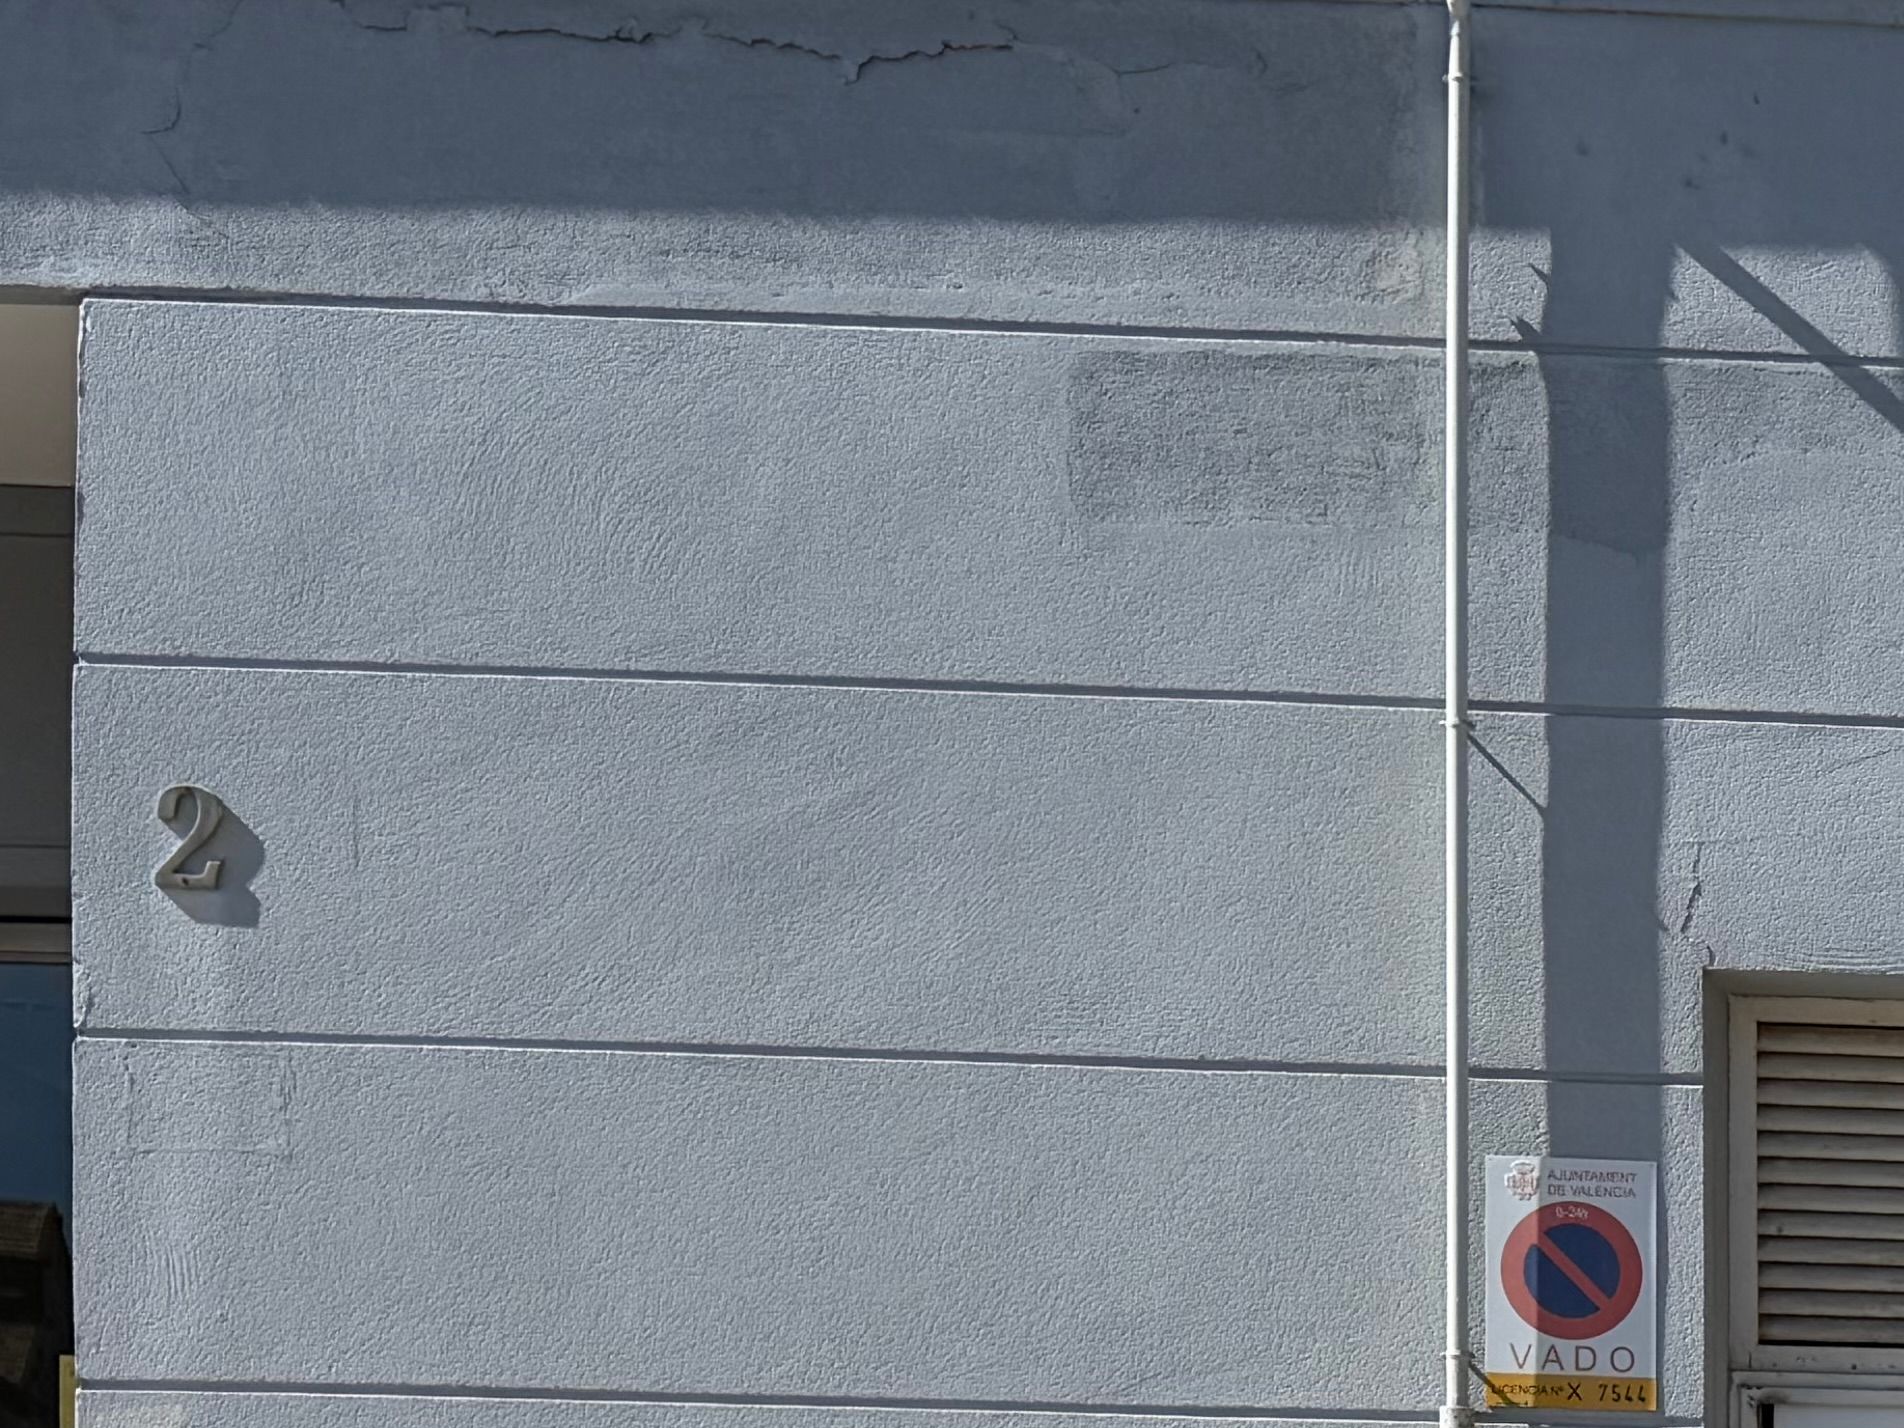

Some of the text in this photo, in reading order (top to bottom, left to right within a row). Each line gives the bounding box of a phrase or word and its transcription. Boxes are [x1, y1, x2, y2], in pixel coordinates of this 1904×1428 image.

[154, 784, 222, 889] 2
[1547, 1168, 1638, 1184] AJUNTAMENT
[1547, 1184, 1566, 1197] DE
[1510, 1341, 1635, 1373] VADO
[1491, 1383, 1548, 1396] LICENCIA
[1567, 1381, 1583, 1401] X
